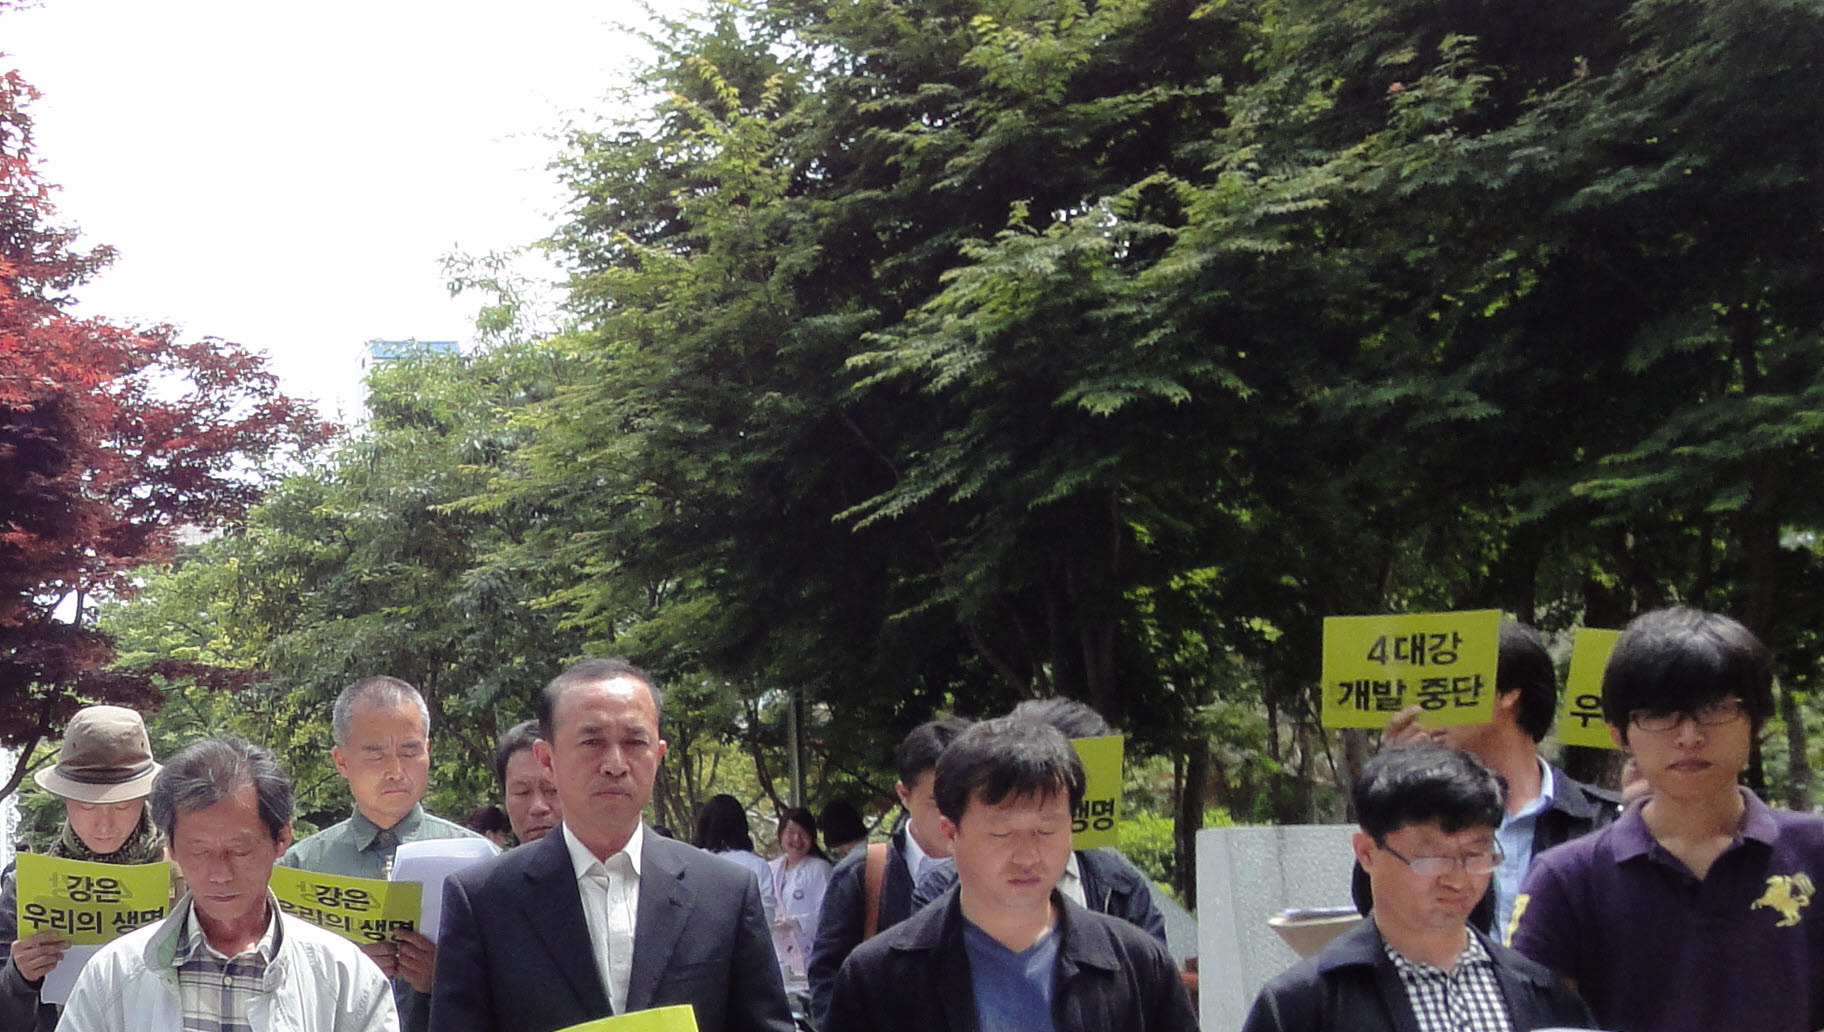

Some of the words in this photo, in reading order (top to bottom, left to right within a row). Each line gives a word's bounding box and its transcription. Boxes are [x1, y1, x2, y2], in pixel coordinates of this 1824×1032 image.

[1367, 631, 1463, 666] 4대강
[1337, 678, 1408, 711] 개발
[1416, 674, 1484, 710] 중단
[67, 875, 122, 902] 강은
[314, 884, 370, 912] 강은
[22, 903, 103, 935] 우리의
